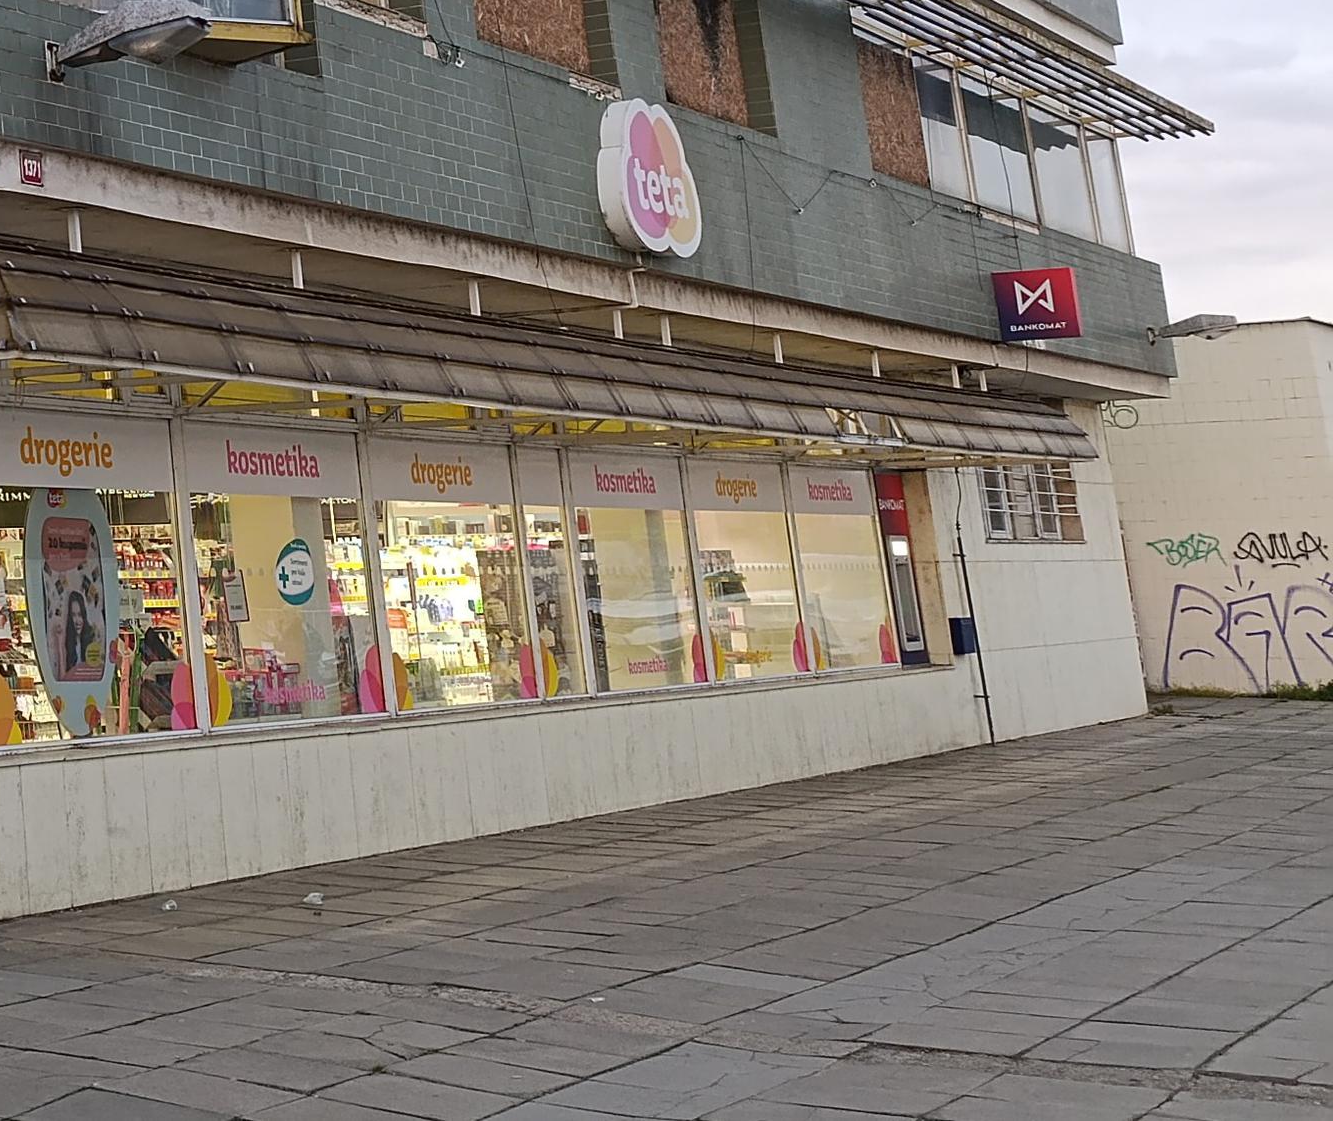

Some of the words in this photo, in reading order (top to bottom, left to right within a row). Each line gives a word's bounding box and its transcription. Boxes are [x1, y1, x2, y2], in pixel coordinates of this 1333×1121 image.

[23, 158, 41, 178] 1371
[633, 157, 690, 219] teta
[1009, 321, 1068, 333] BANKOMAT
[20, 426, 113, 477] drogerie
[225, 439, 321, 478] kosmetika
[410, 453, 473, 494] drogerie
[594, 464, 657, 495] kosmetika
[715, 471, 758, 504] drogerie
[807, 478, 854, 503] kosmetika
[878, 498, 905, 511] BANKOMAT
